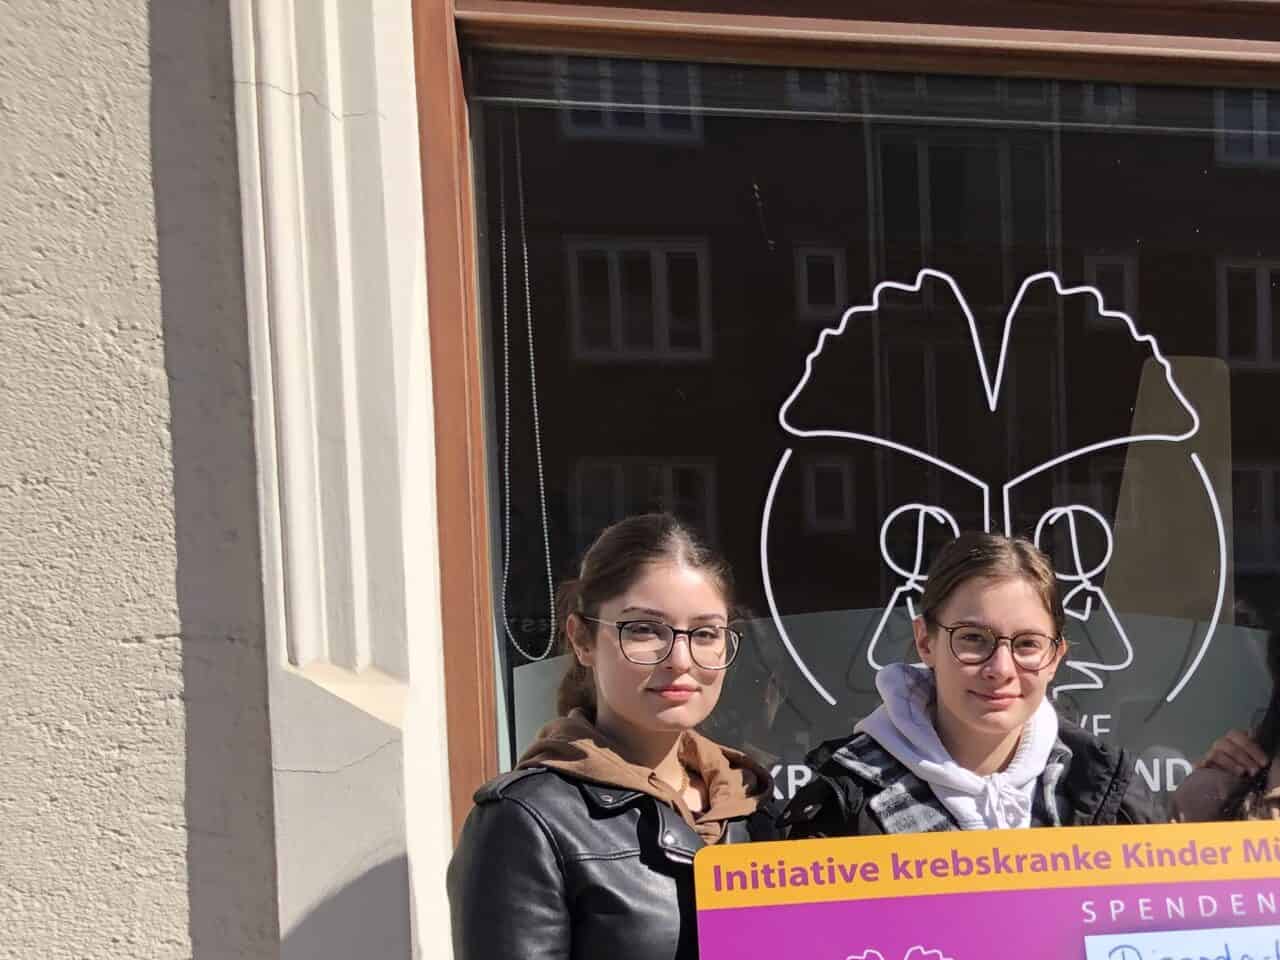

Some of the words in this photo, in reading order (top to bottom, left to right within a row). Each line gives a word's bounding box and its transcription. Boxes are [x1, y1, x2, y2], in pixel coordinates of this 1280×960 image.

[713, 857, 880, 892] Initiative
[890, 843, 1112, 881] krebskranke
[1122, 839, 1232, 869] Kinder
